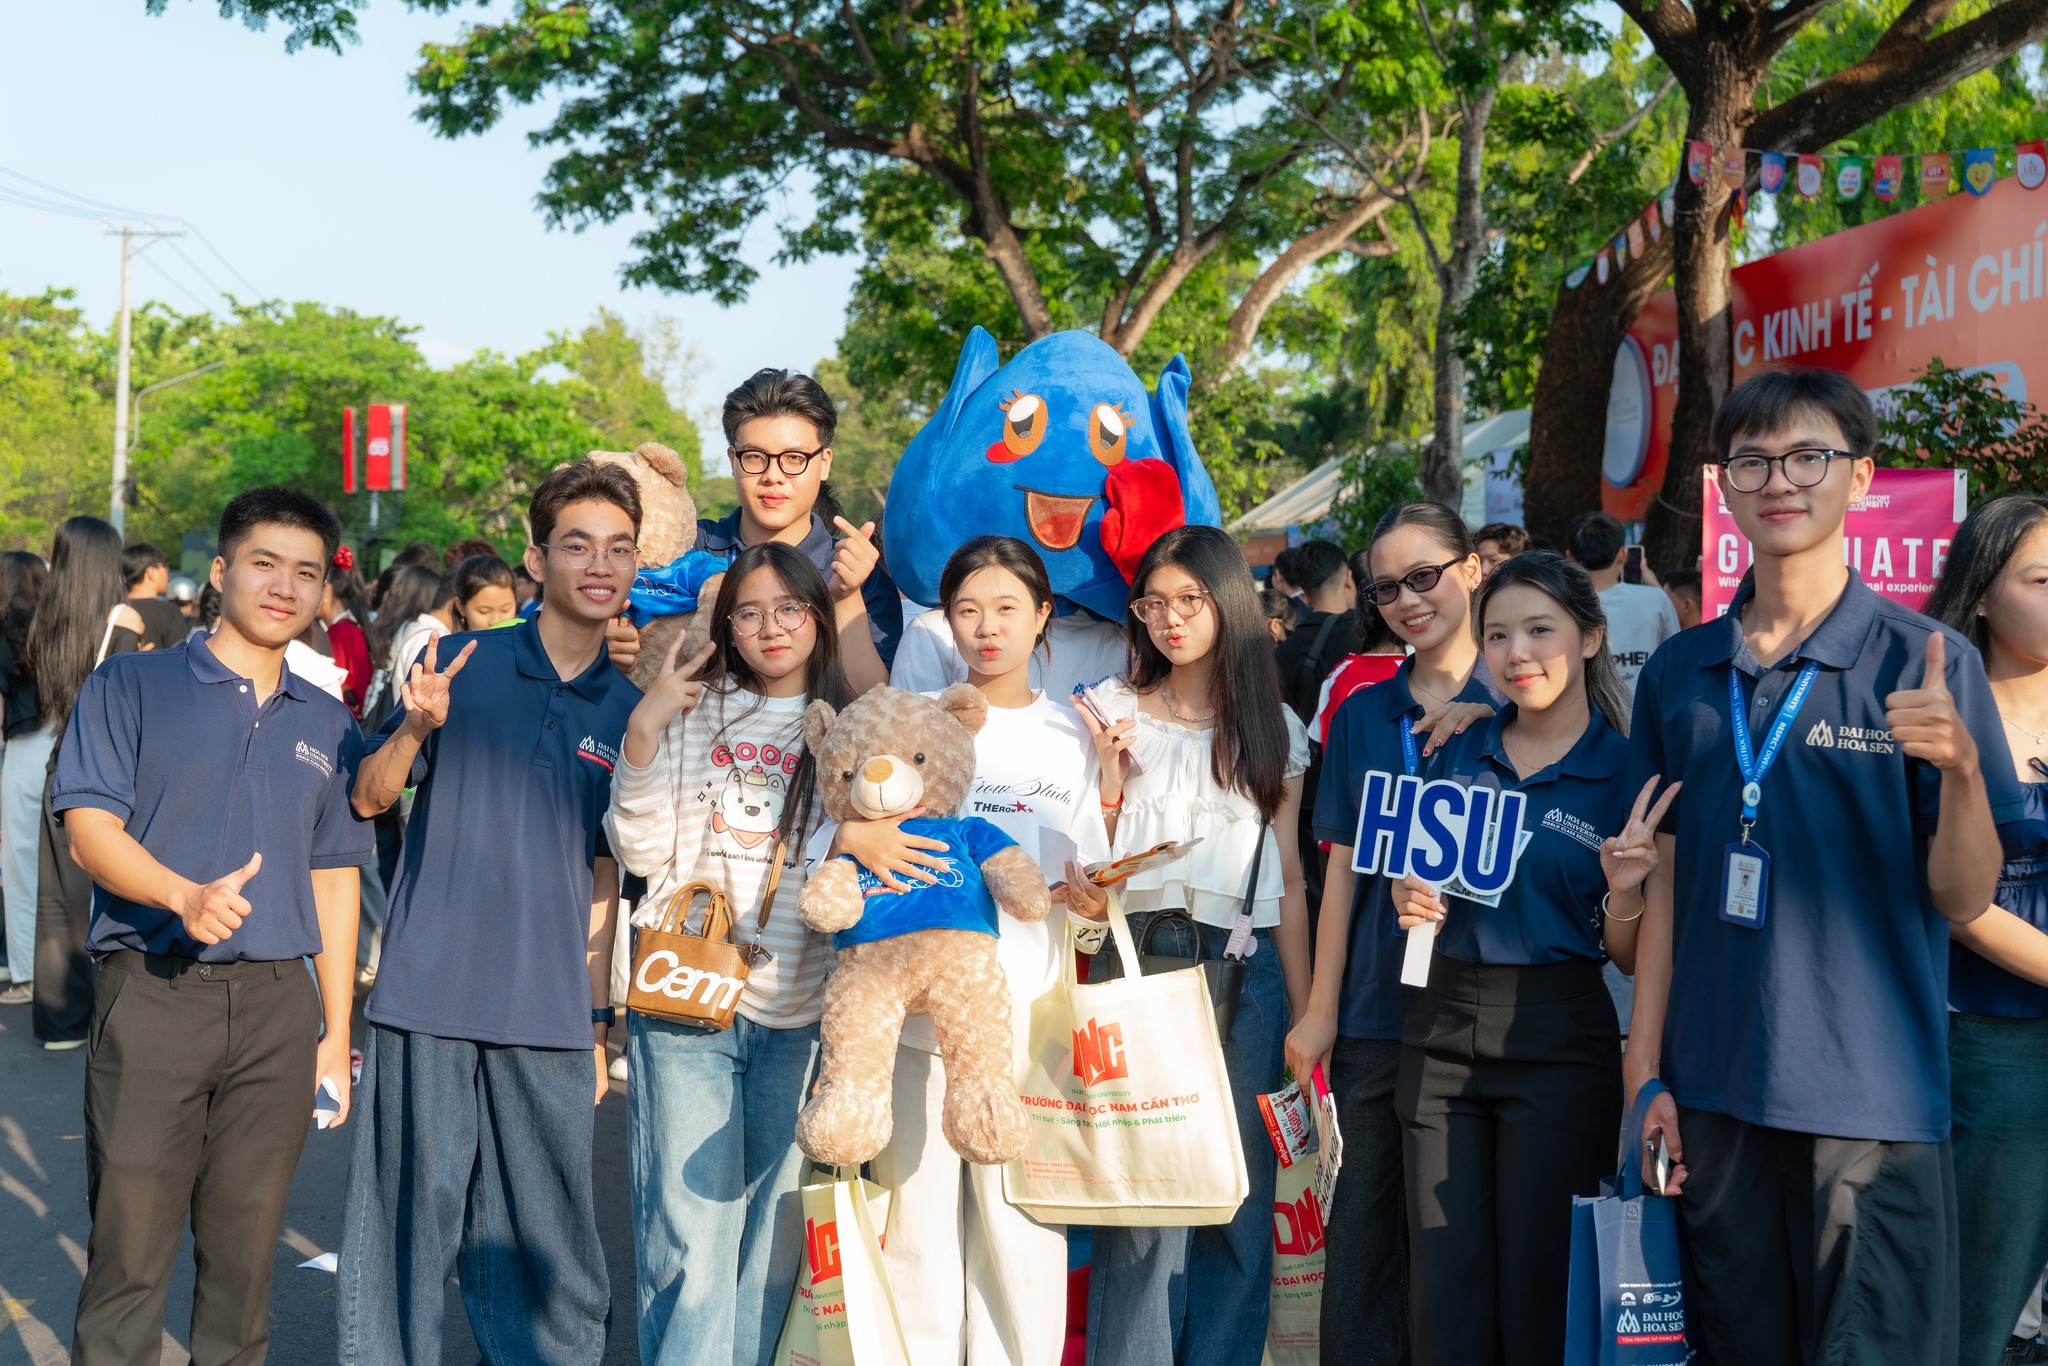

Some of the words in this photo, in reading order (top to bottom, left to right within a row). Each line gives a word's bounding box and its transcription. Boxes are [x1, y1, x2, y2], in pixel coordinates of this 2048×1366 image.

[1763, 297, 1832, 361] KINH
[1840, 261, 1880, 343] TẾ
[1901, 254, 1955, 329] TÀI
[1968, 220, 2048, 313] CHÍ
[1886, 582, 1936, 594] experien
[1788, 672, 1813, 710] UNIVERSITY
[1770, 721, 1786, 750] RESPECT
[596, 749, 610, 760] HOA
[1837, 738, 1868, 752] HOA
[1869, 742, 1894, 755] SEN
[1560, 826, 1576, 836] CLASS
[1562, 819, 1605, 842] UNIVERSITY
[1565, 813, 1580, 825] HOA
[1580, 821, 1596, 832] SEN
[1355, 774, 1522, 891] HSU
[1071, 1017, 1128, 1089] NC
[1020, 1095, 1063, 1110] TRƯỜNG
[1066, 1102, 1086, 1114] ĐẠI
[1088, 1104, 1106, 1118] ỌC
[1110, 1102, 1138, 1112] NAM
[1141, 1096, 1170, 1111] CẦN
[1172, 1092, 1200, 1106] THƠ
[1061, 1117, 1080, 1127] Sáng
[1095, 1120, 1110, 1130] Hội
[1112, 1118, 1132, 1128] nhập
[1142, 1116, 1163, 1126] Phát
[1164, 1113, 1187, 1123] triển
[1282, 1276, 1300, 1287] ĐẠI
[1302, 1272, 1324, 1284] HỌC
[1642, 1312, 1662, 1322] ĐẠI
[1664, 1310, 1684, 1320] HỌC
[824, 1320, 846, 1330] nhập
[1643, 1323, 1667, 1332] HOA
